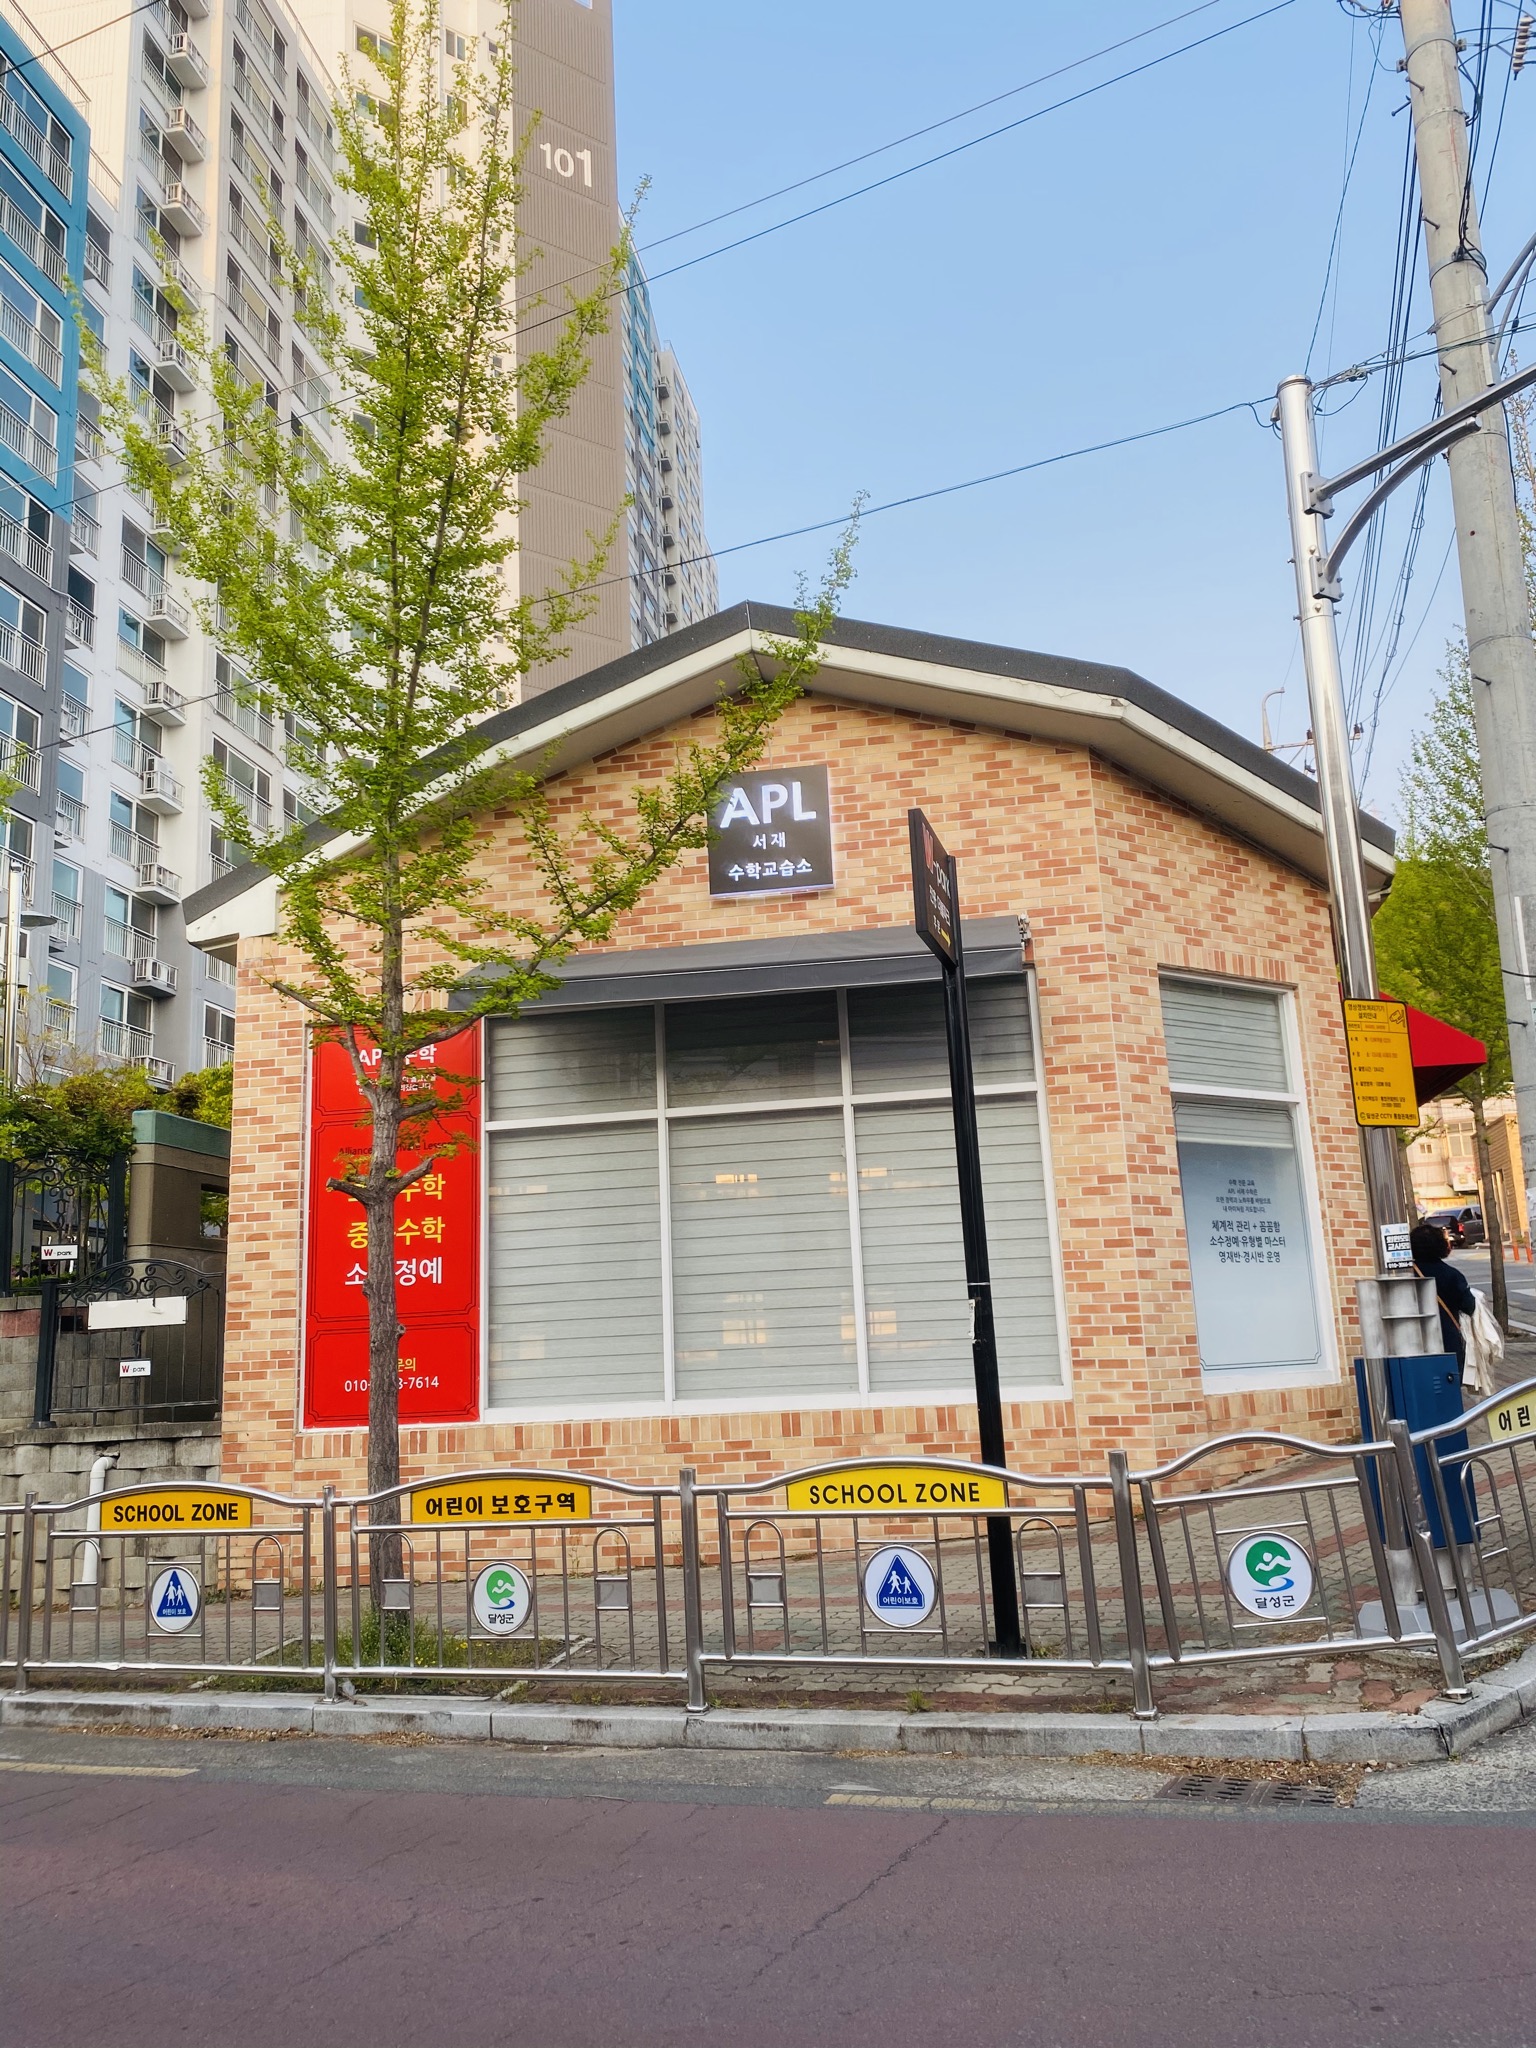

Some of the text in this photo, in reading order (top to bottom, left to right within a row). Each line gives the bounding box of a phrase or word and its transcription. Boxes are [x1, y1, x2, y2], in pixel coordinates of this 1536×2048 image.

[539, 142, 593, 188] 101
[720, 781, 817, 828] APL
[752, 831, 786, 850] 서재
[728, 858, 813, 881] 수학교습소
[347, 1216, 446, 1249] 중수학
[1212, 1220, 1234, 1232] 체계적
[1236, 1221, 1250, 1232] 관리
[1259, 1220, 1281, 1233] 꼼꼼함
[1264, 1236, 1286, 1248] 마스터
[1266, 1250, 1281, 1263] 운영
[344, 1256, 442, 1286] 소정예
[810, 1482, 980, 1505] SCHOOL ZONE
[113, 1502, 239, 1523] SCHOOL ZONE
[425, 1493, 576, 1517] 어린이 보호구역
[1255, 1595, 1296, 1609] 달성군
[488, 1613, 515, 1625] 달성군
